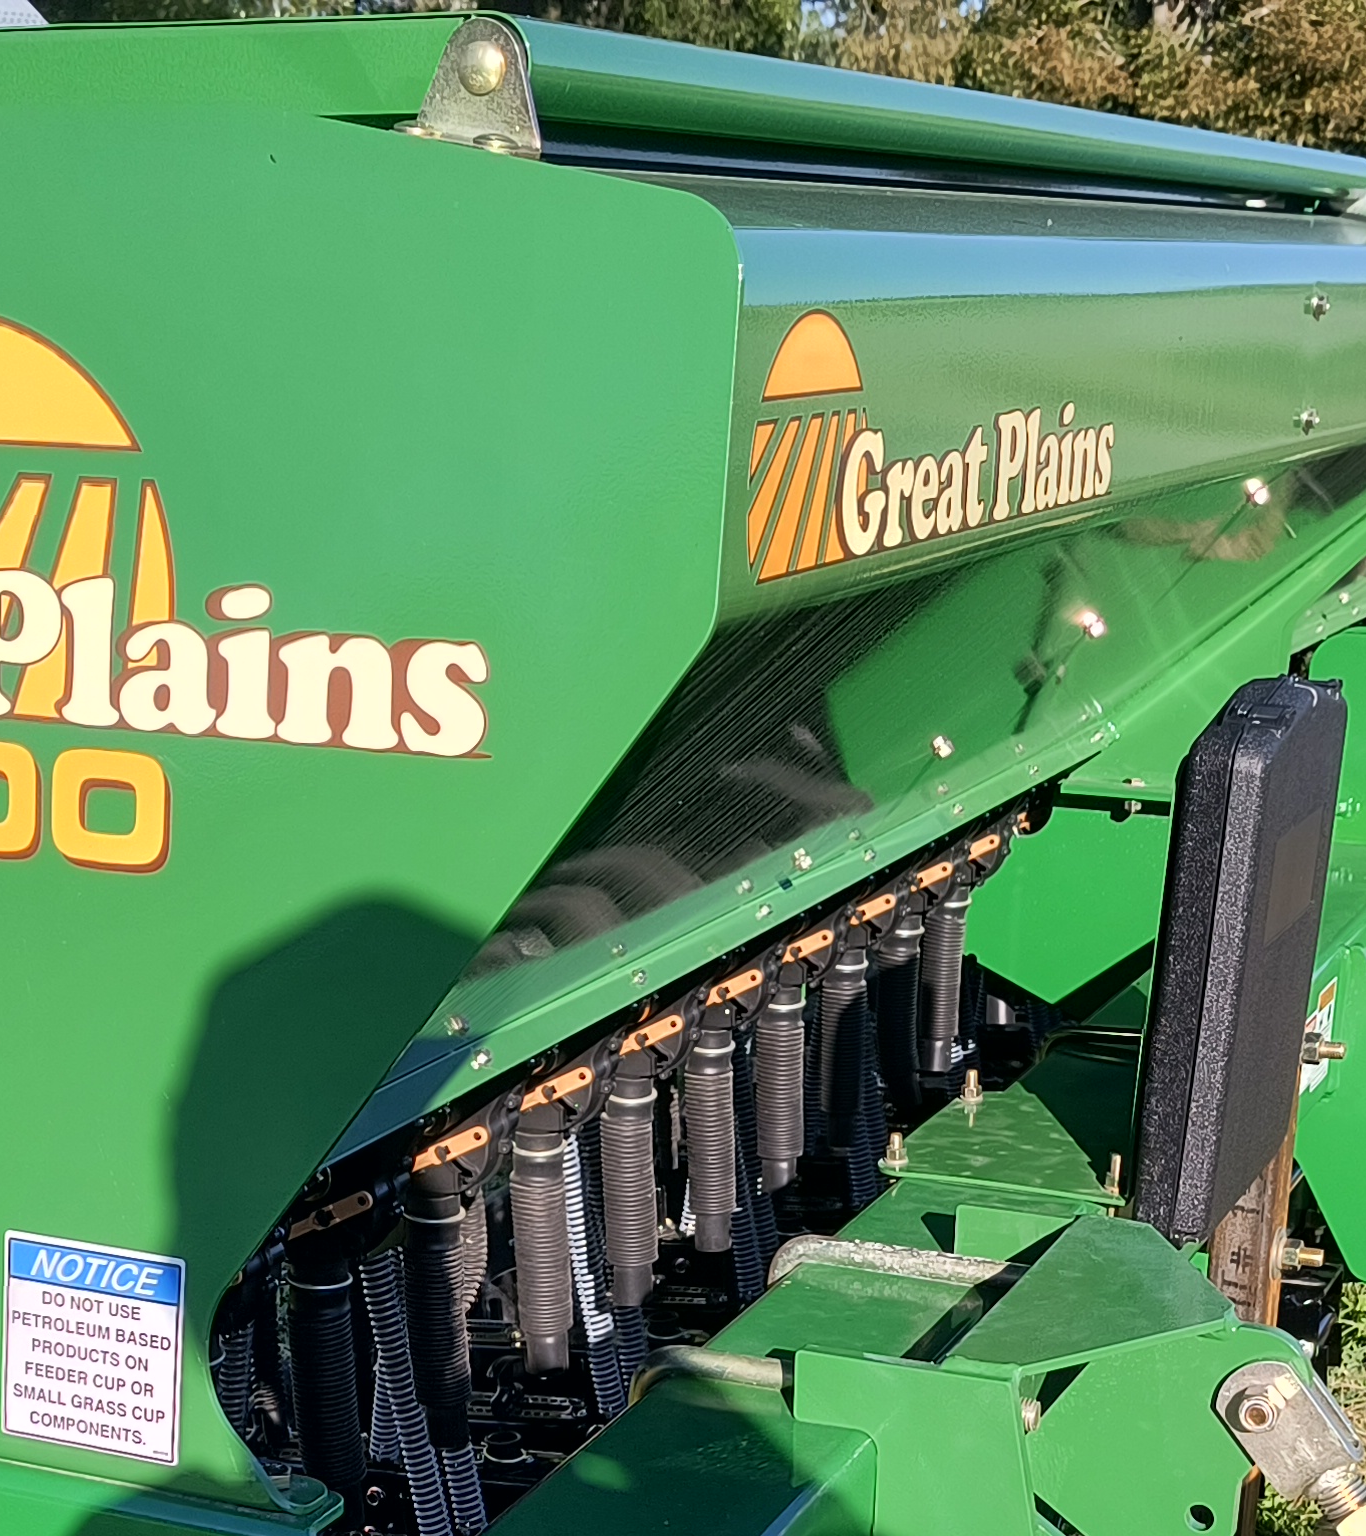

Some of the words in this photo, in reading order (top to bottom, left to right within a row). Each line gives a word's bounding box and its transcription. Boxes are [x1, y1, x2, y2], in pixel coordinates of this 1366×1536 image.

[841, 425, 989, 557] Great
[990, 401, 1115, 522] Plains
[30, 1248, 164, 1296] NOTICE
[41, 1290, 66, 1308] DO
[70, 1295, 104, 1315] NOT
[108, 1302, 142, 1321] USE
[11, 1309, 110, 1341] PETROLEUM
[115, 1328, 171, 1351] BASED
[31, 1337, 120, 1367] PRODUCTS
[124, 1354, 149, 1372] ON
[24, 1360, 88, 1386] FEEDER
[92, 1373, 126, 1393] CUP
[130, 1381, 154, 1398] OR
[12, 1383, 67, 1407] SMALL
[70, 1393, 127, 1418] GRASS
[131, 1406, 165, 1424] CUP
[29, 1410, 147, 1446] COMPONENTS.
